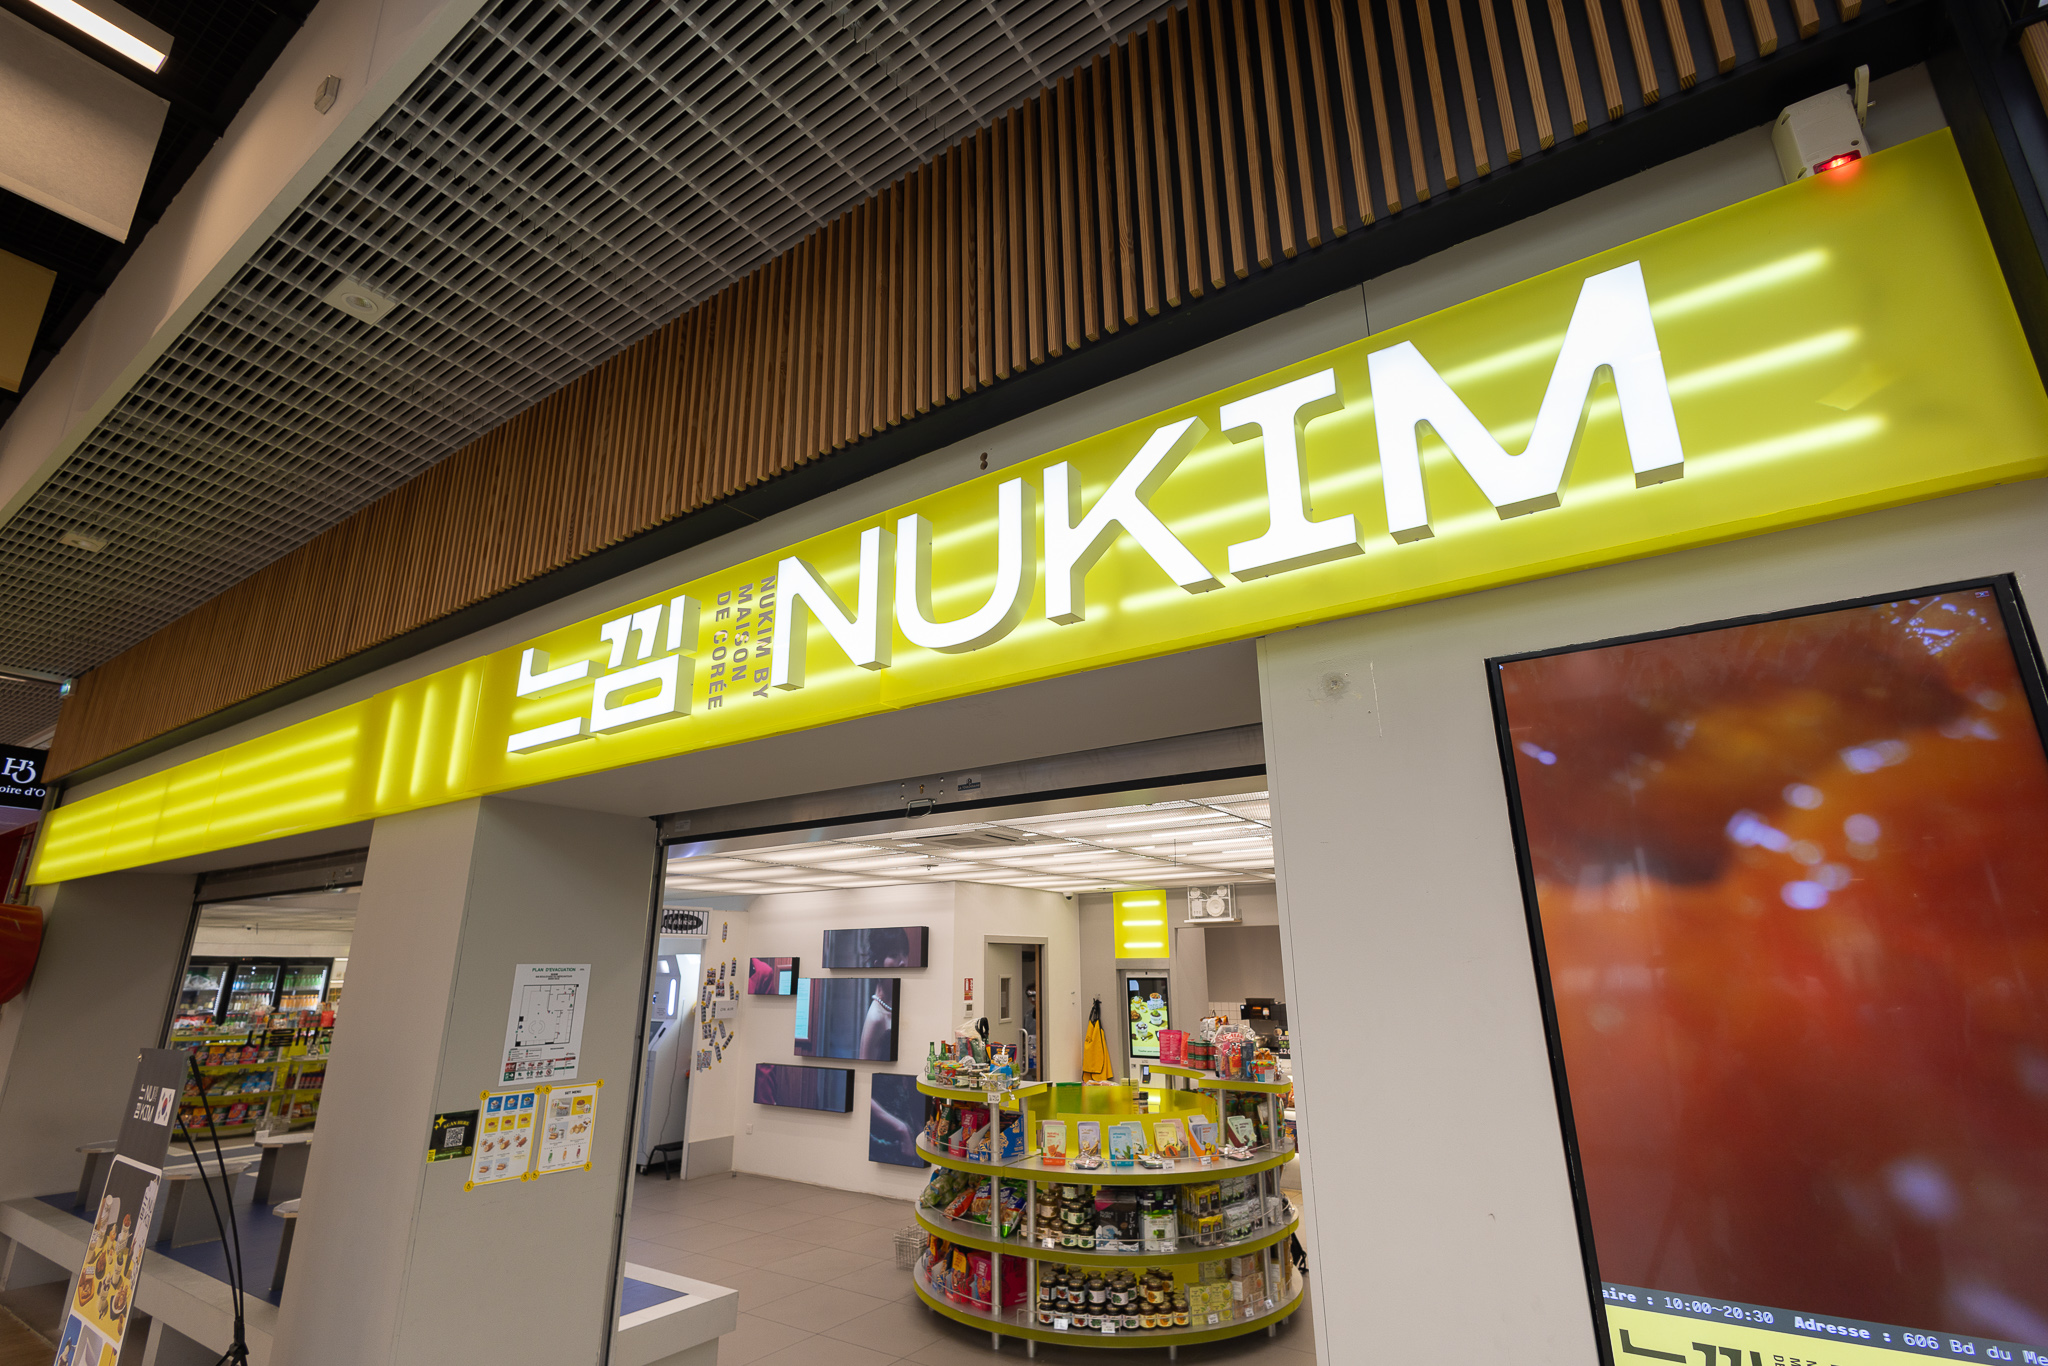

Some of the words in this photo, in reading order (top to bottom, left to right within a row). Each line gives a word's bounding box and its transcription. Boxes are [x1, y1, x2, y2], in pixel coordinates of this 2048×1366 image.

[772, 261, 1684, 691] NUKIM
[715, 590, 731, 622] DE
[731, 583, 754, 681] MAISON
[754, 575, 776, 659] NUKIM
[507, 595, 690, 754] 느낌
[707, 630, 728, 710] CORÉE
[752, 667, 770, 699] BY
[443, 1121, 457, 1129] SCAN
[1602, 1287, 1637, 1303] aire
[1664, 1296, 1774, 1324] 10:00~20:30
[1794, 1316, 1871, 1339] Adresse
[1903, 1332, 1940, 1350] 606
[1949, 1339, 1976, 1356] Bd
[1986, 1346, 2012, 1362] du
[2022, 1350, 2048, 1366] Me
